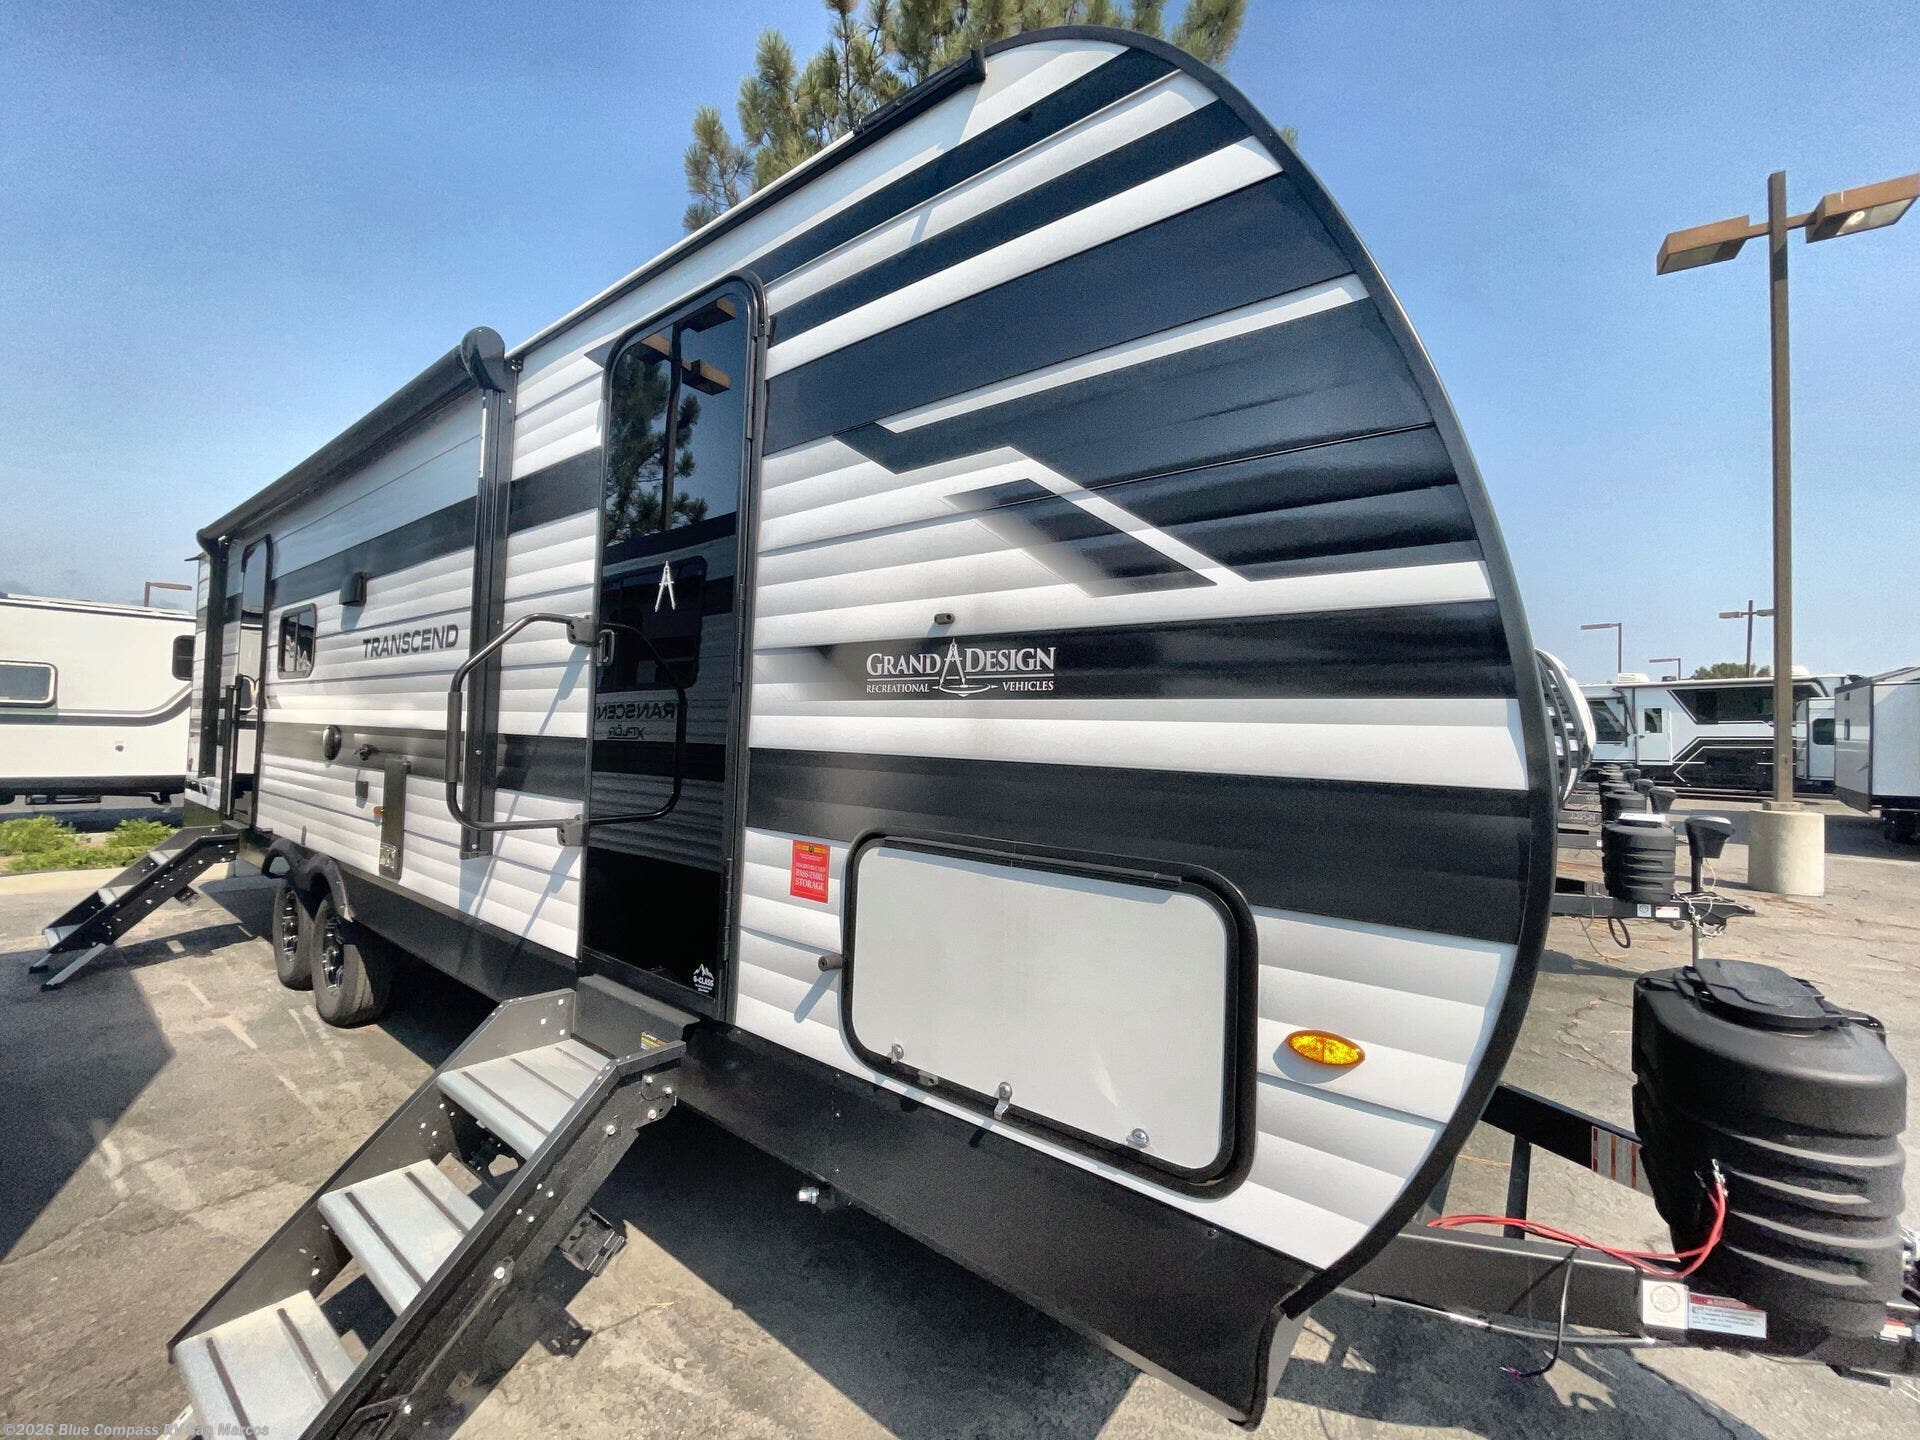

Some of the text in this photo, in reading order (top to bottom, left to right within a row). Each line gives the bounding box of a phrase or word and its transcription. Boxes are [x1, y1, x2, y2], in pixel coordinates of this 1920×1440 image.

[362, 624, 459, 658] TRANSCEND
[866, 647, 1057, 676] GRAND DESIGN
[866, 680, 1054, 693] RECREATIONAL VEHICLES
[794, 878, 826, 891] STORAGE
